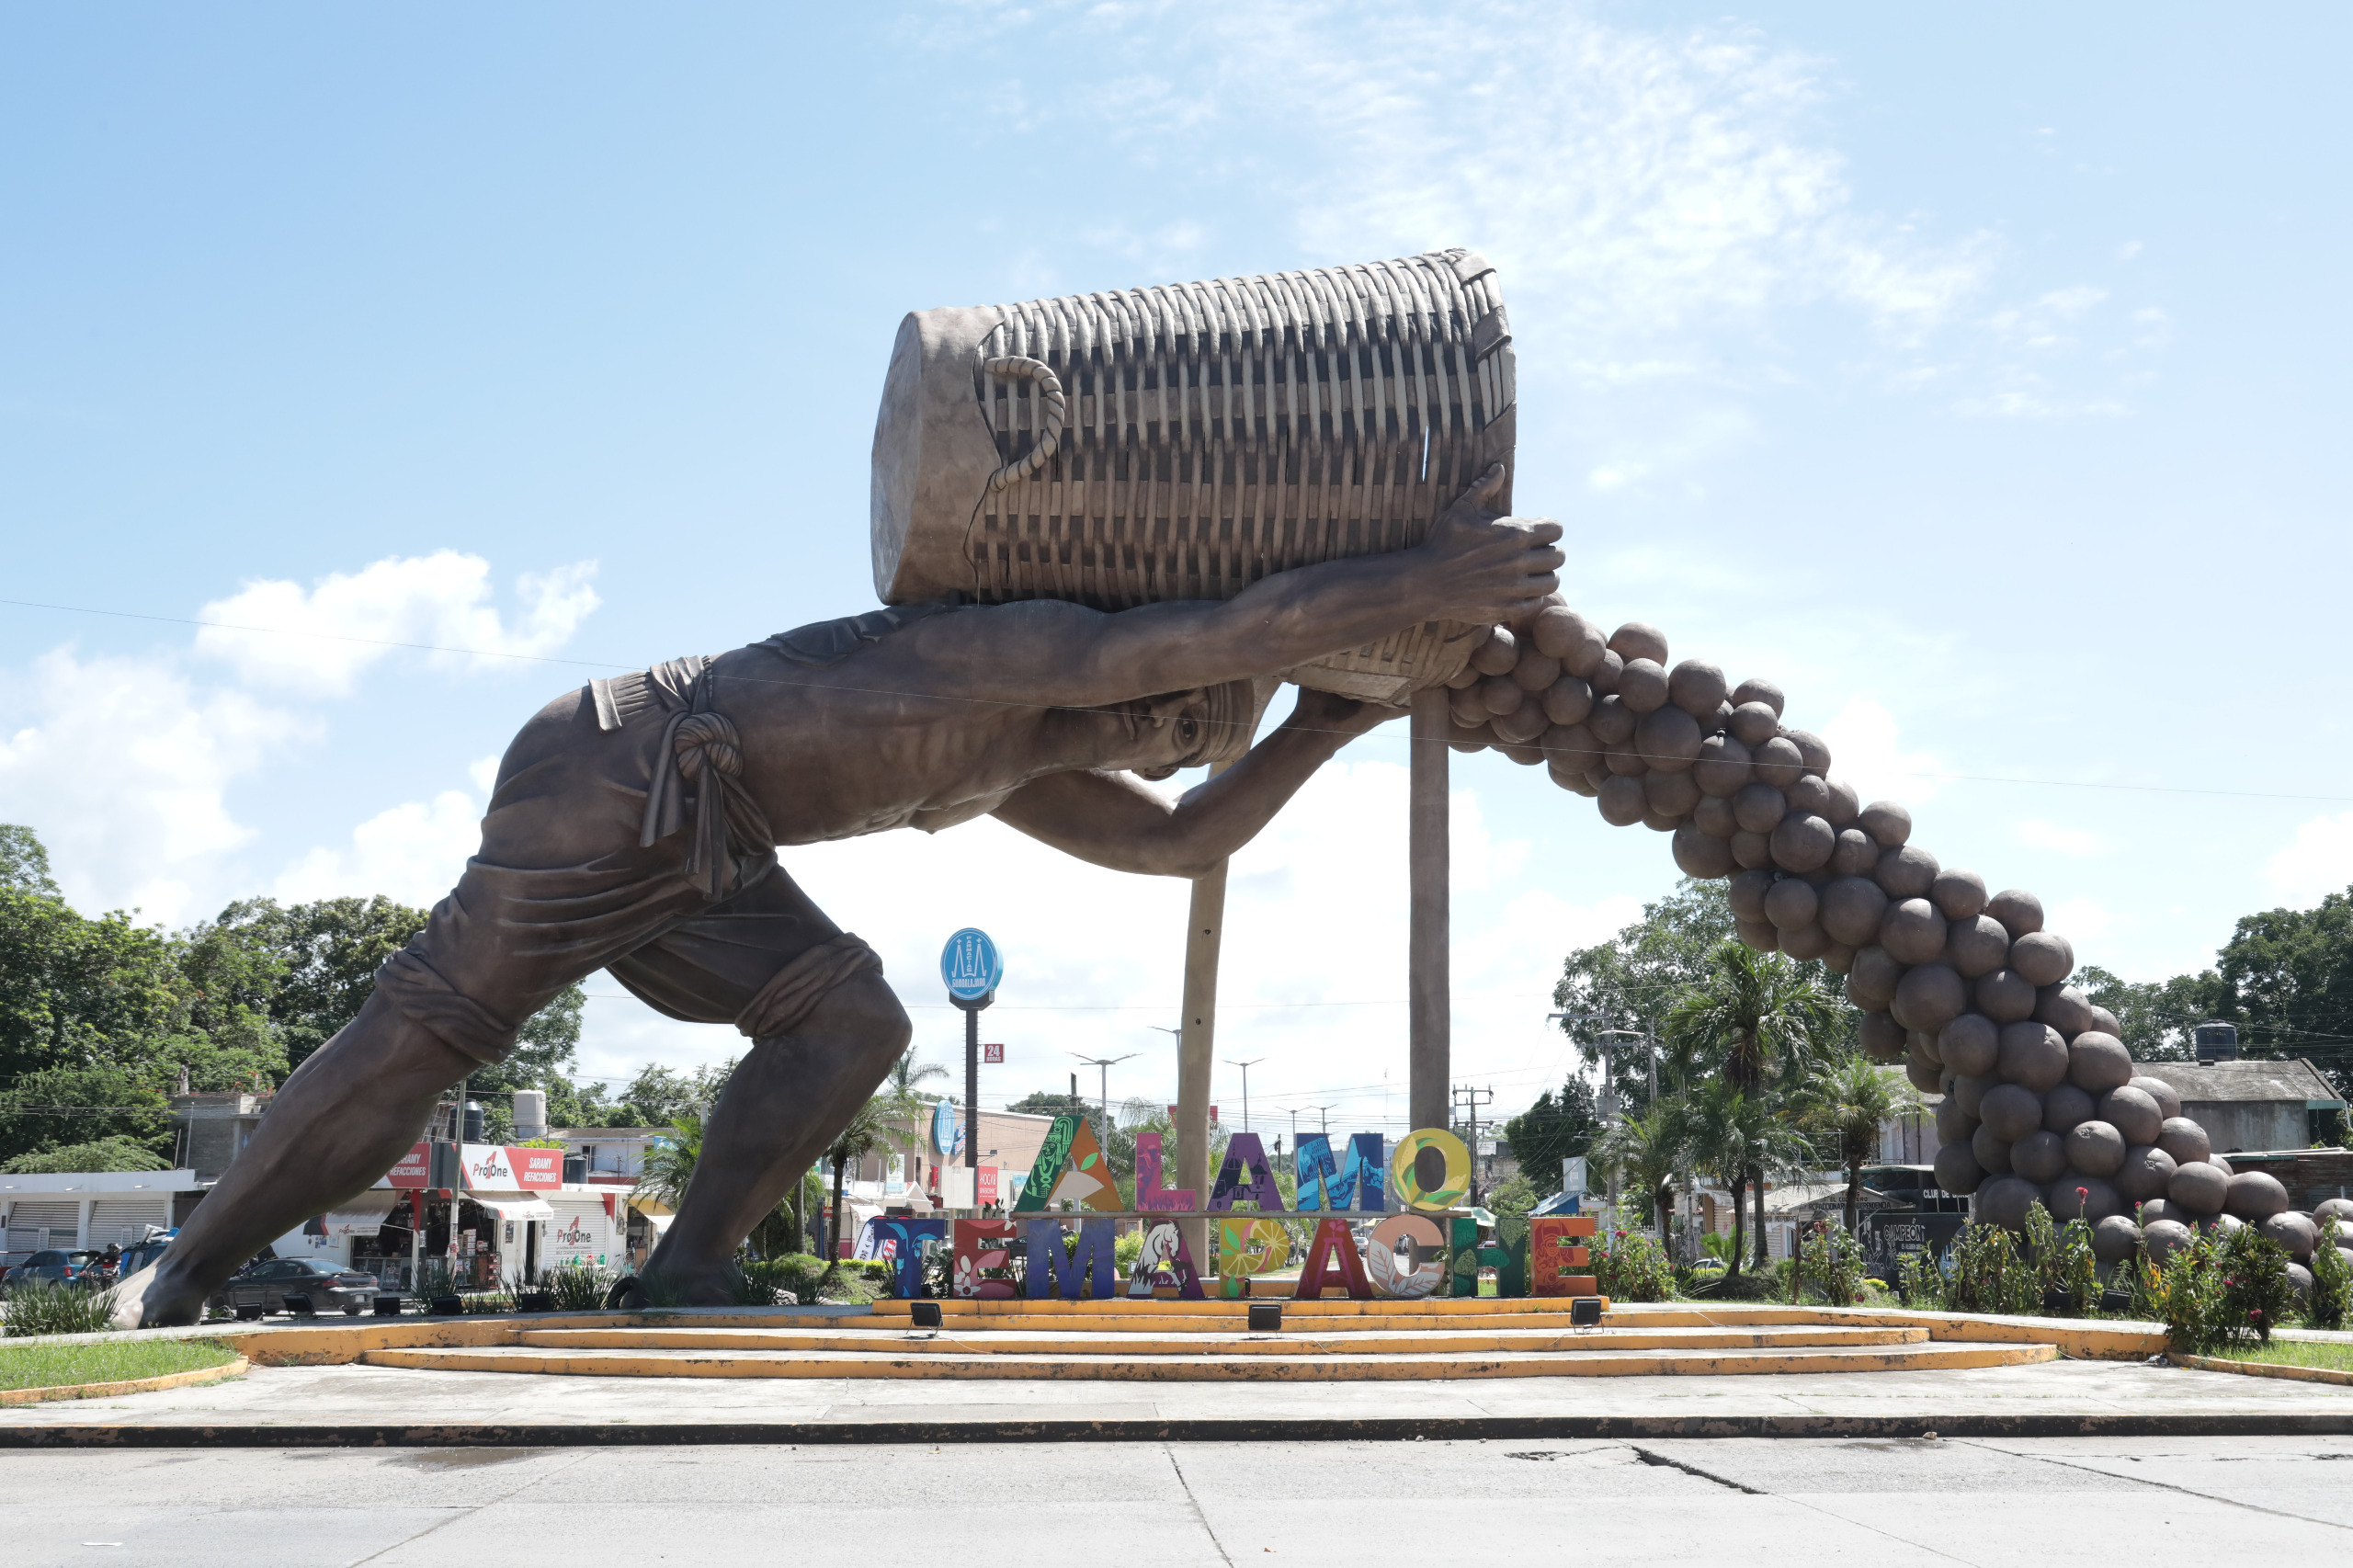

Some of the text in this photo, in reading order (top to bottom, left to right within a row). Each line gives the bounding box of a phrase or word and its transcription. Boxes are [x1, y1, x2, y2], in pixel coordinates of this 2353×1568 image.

[987, 1045, 1000, 1057] 24
[529, 1157, 552, 1170] SARAMY
[1015, 1115, 1471, 1211] ALAMO
[390, 1167, 426, 1176] REFACCIONES
[523, 1172, 557, 1183] REFACCIONES
[1923, 1189, 1939, 1199] CLUB
[874, 1214, 1597, 1299] TEMAPACHE
